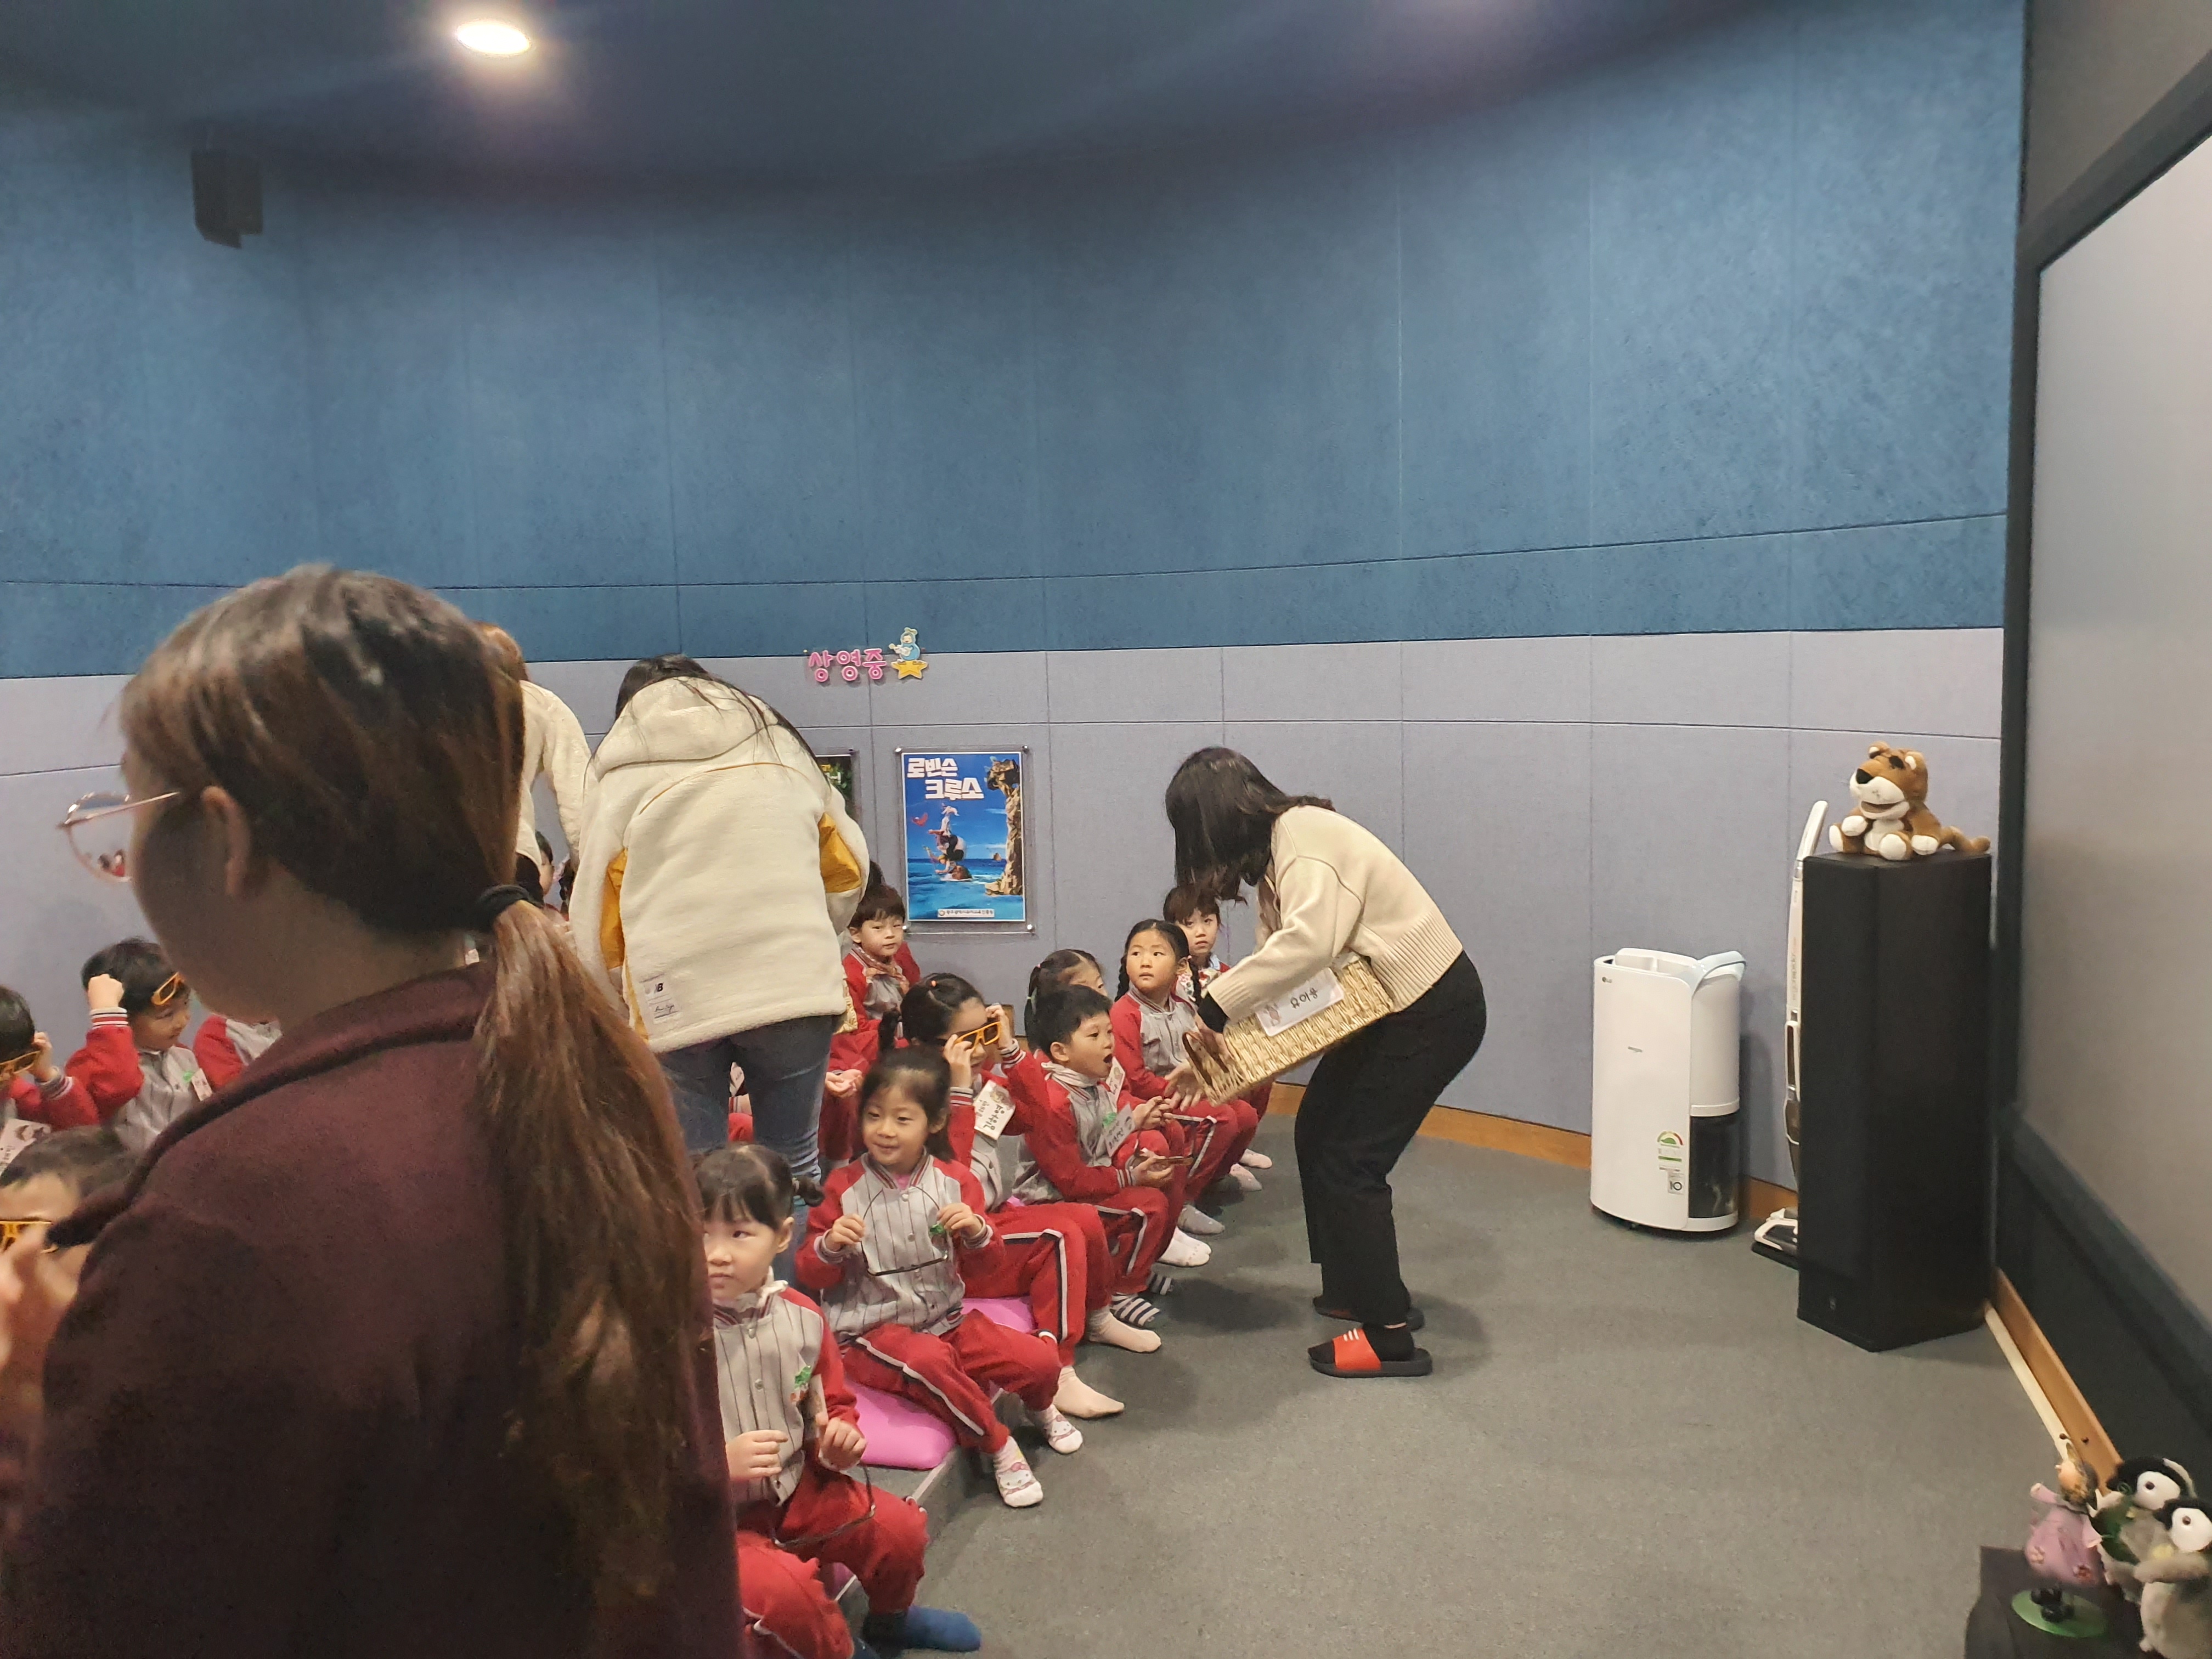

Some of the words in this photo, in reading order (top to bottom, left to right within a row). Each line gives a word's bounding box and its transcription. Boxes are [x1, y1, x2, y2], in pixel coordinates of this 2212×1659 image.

[809, 648, 887, 682] 상영중
[907, 757, 958, 778] 로빈슨
[925, 777, 985, 800] 크루소
